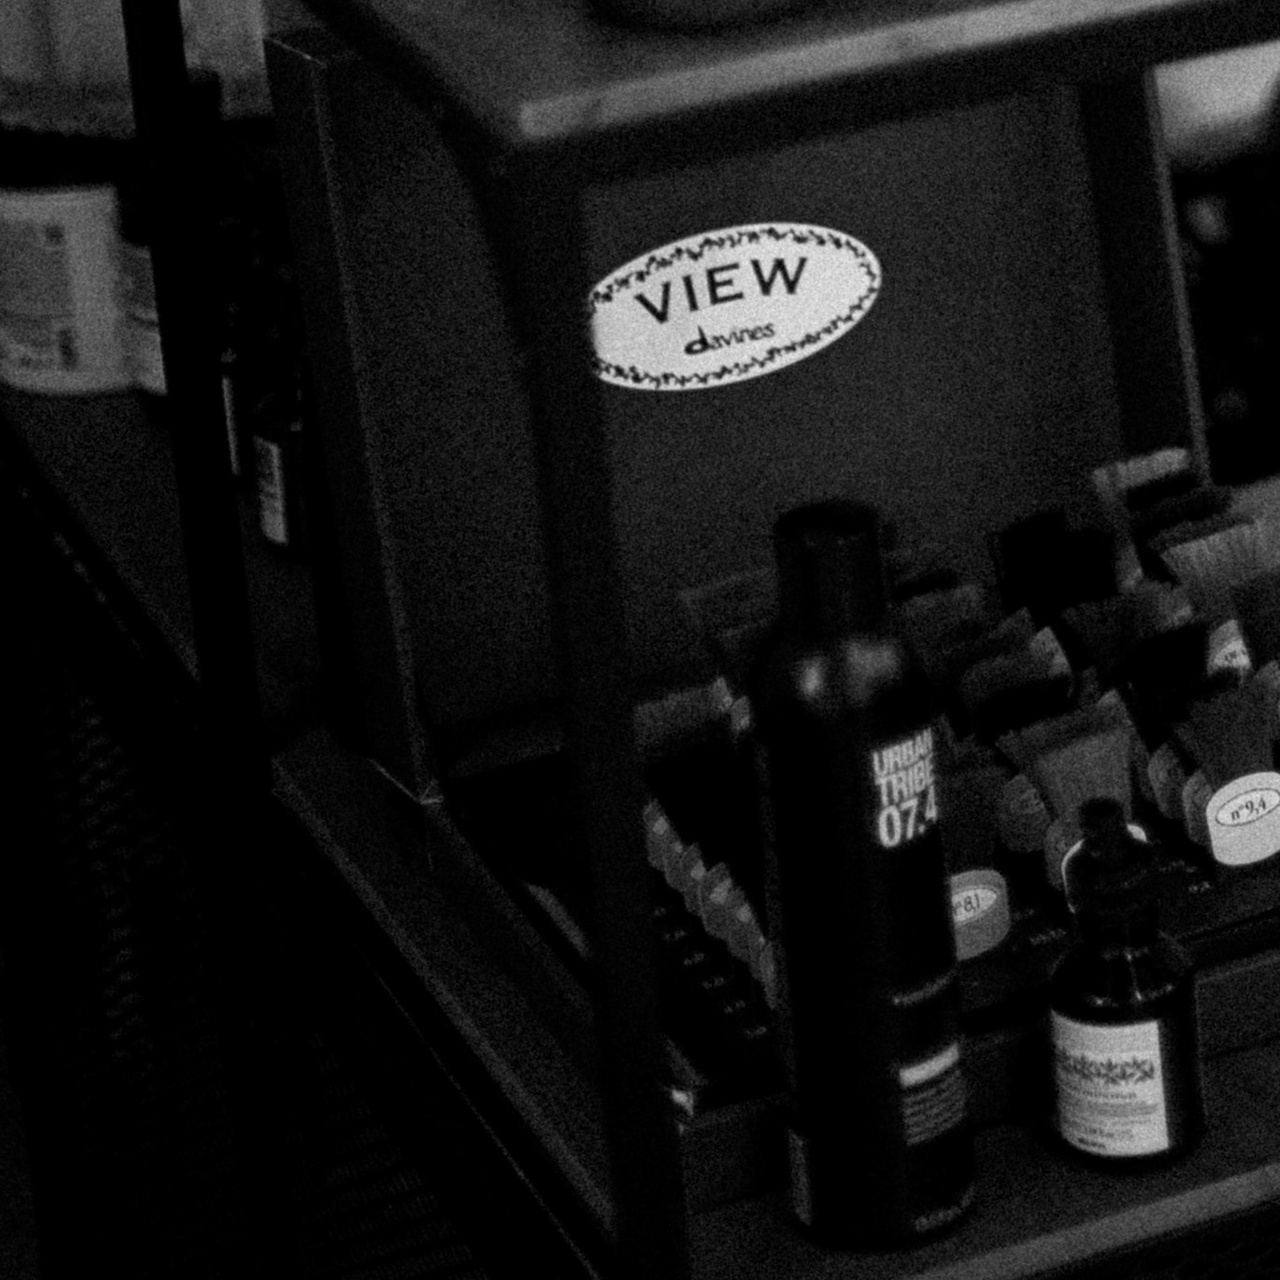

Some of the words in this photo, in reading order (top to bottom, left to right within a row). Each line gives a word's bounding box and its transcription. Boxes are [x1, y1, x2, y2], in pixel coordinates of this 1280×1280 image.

[634, 257, 808, 324] VIEW
[684, 323, 775, 355] davines
[872, 727, 933, 778] URBAN
[875, 754, 936, 807] TRIBE
[879, 785, 938, 848] 07.4
[1231, 797, 1267, 821] n°9,4
